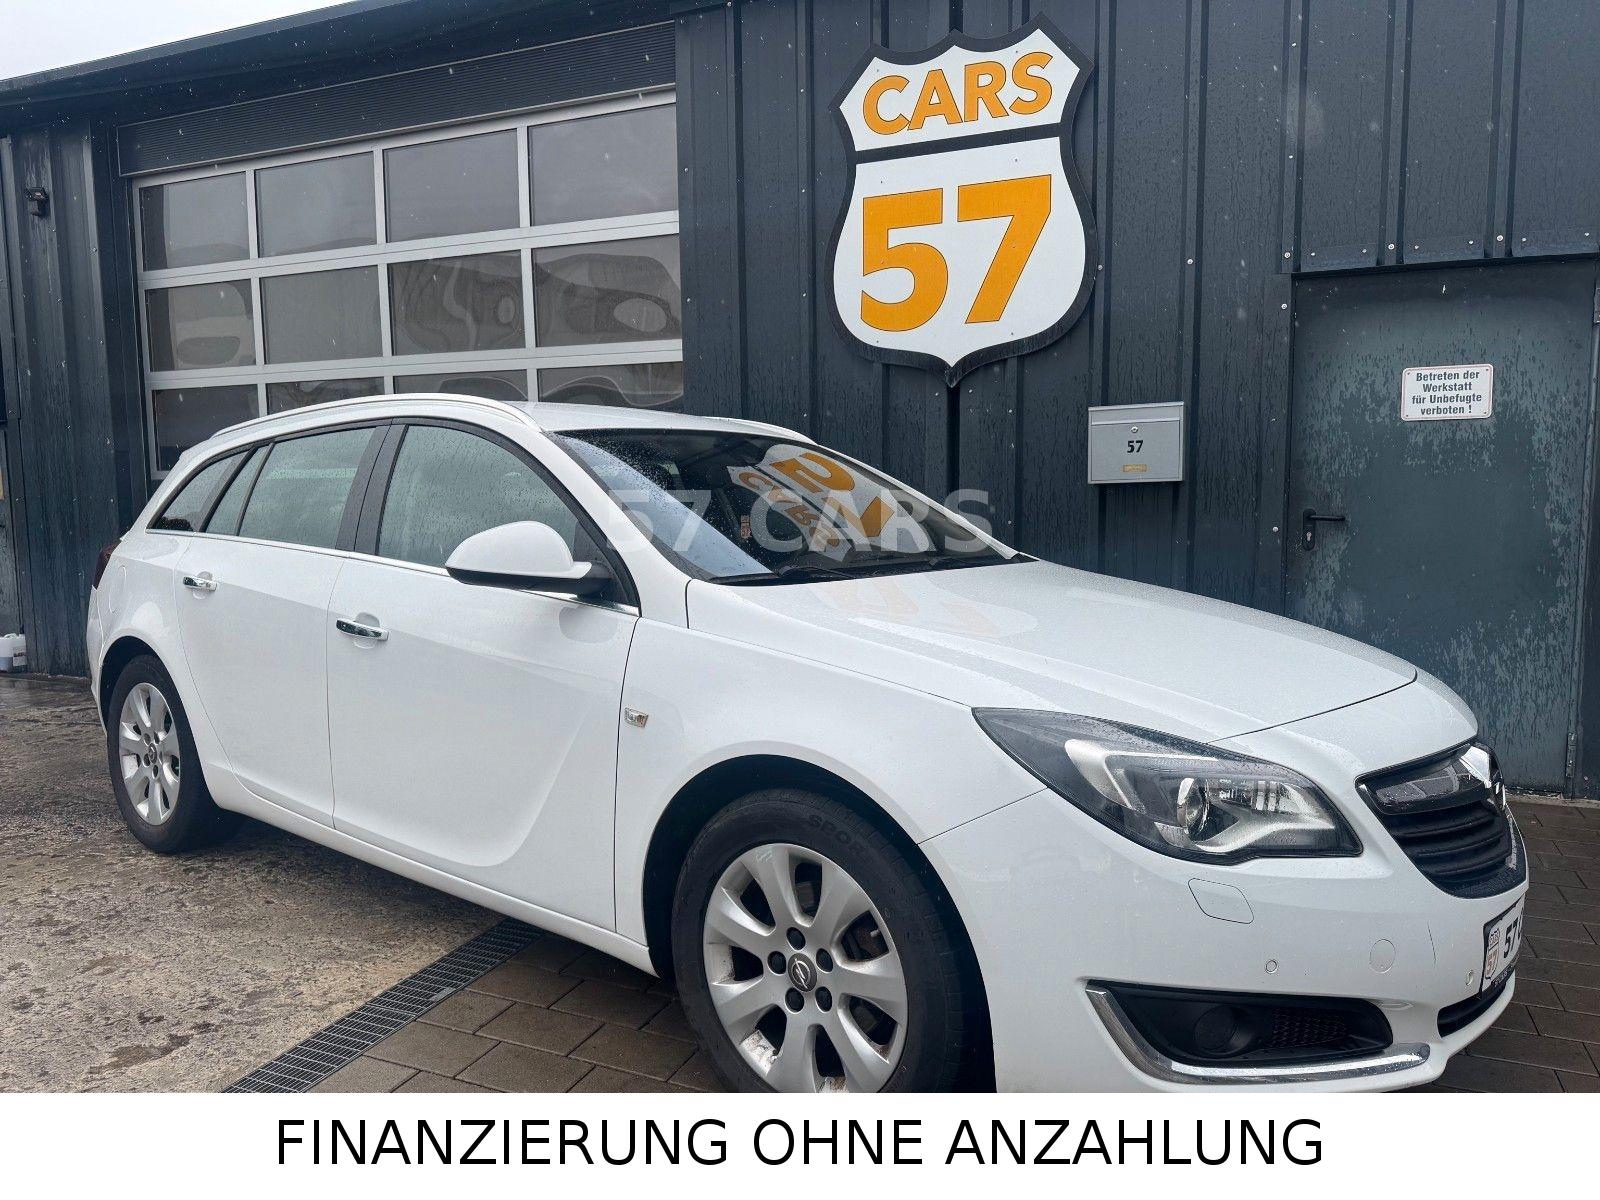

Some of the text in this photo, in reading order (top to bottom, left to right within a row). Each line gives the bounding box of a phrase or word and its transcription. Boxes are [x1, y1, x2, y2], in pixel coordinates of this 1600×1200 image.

[863, 52, 1053, 135] CARS
[861, 174, 1052, 332] 57
[1416, 371, 1480, 381] Betreten der
[1423, 382, 1472, 392] Werkstatt
[1412, 393, 1482, 404] für Unbefugte
[1421, 406, 1465, 415] verboten
[1127, 440, 1143, 453] 57
